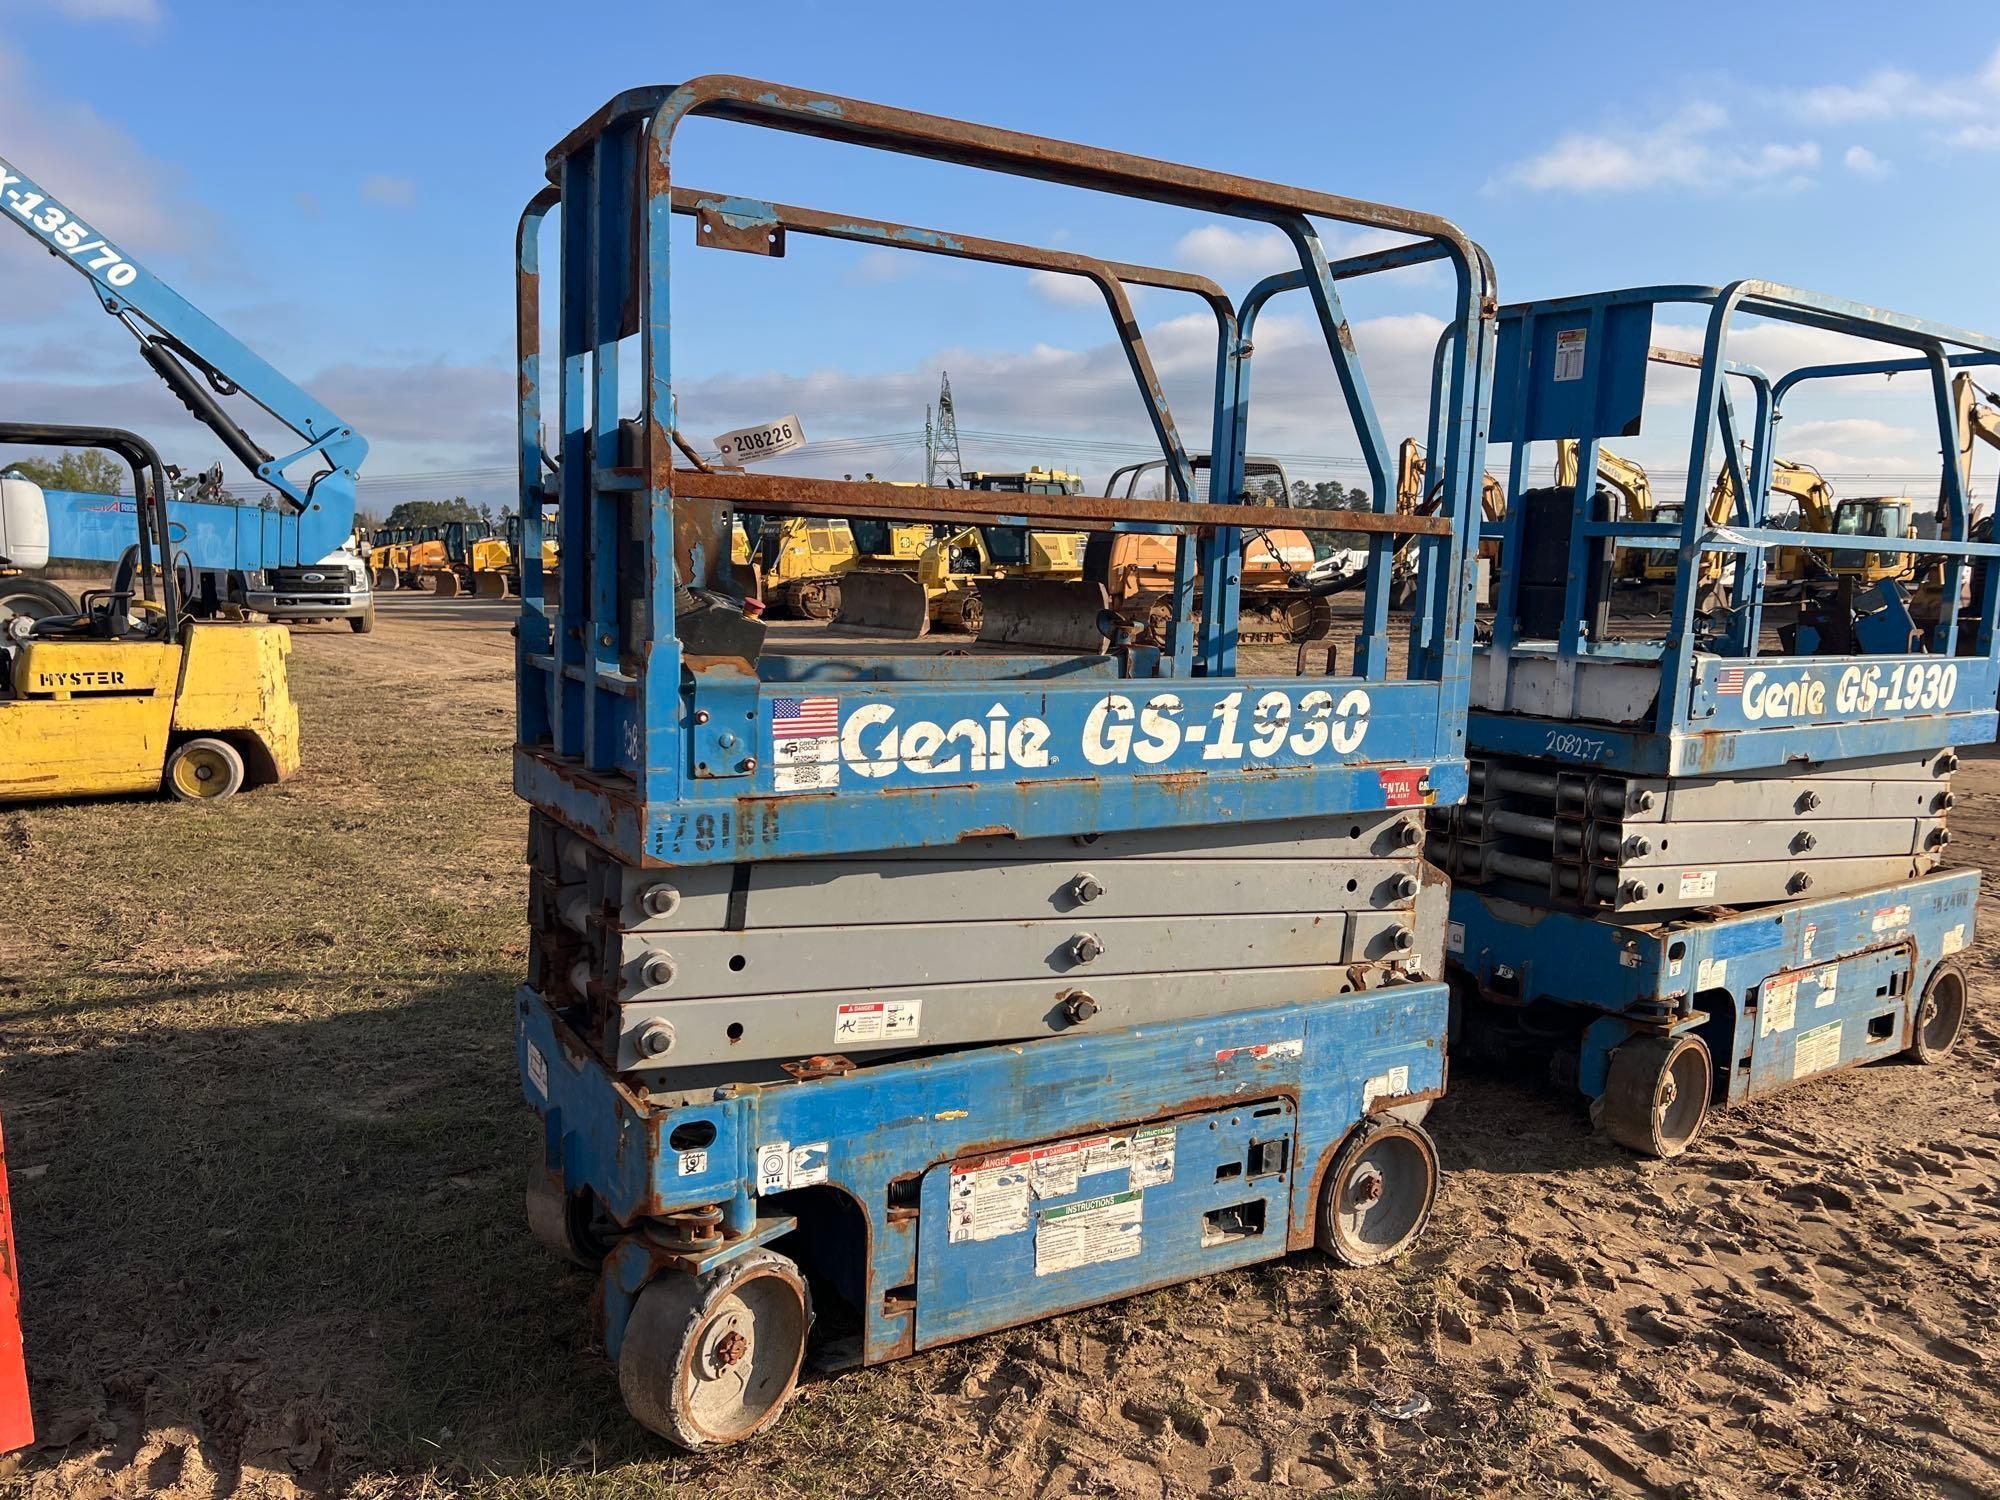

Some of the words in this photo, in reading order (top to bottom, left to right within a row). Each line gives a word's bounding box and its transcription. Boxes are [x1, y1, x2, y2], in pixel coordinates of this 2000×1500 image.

[733, 423, 792, 452] 208226
[40, 671, 124, 687] HYSTER
[1742, 670, 1826, 721] Genie
[1836, 664, 1958, 714] GS-1930
[841, 702, 1052, 779] Genie
[1082, 688, 1372, 766] GS-1930
[853, 1004, 875, 1012] DANGER
[1138, 1127, 1173, 1138] STRUCTIONS
[1049, 1145, 1072, 1156] DANGER
[1065, 1197, 1115, 1215] INSTRUCTIONS
